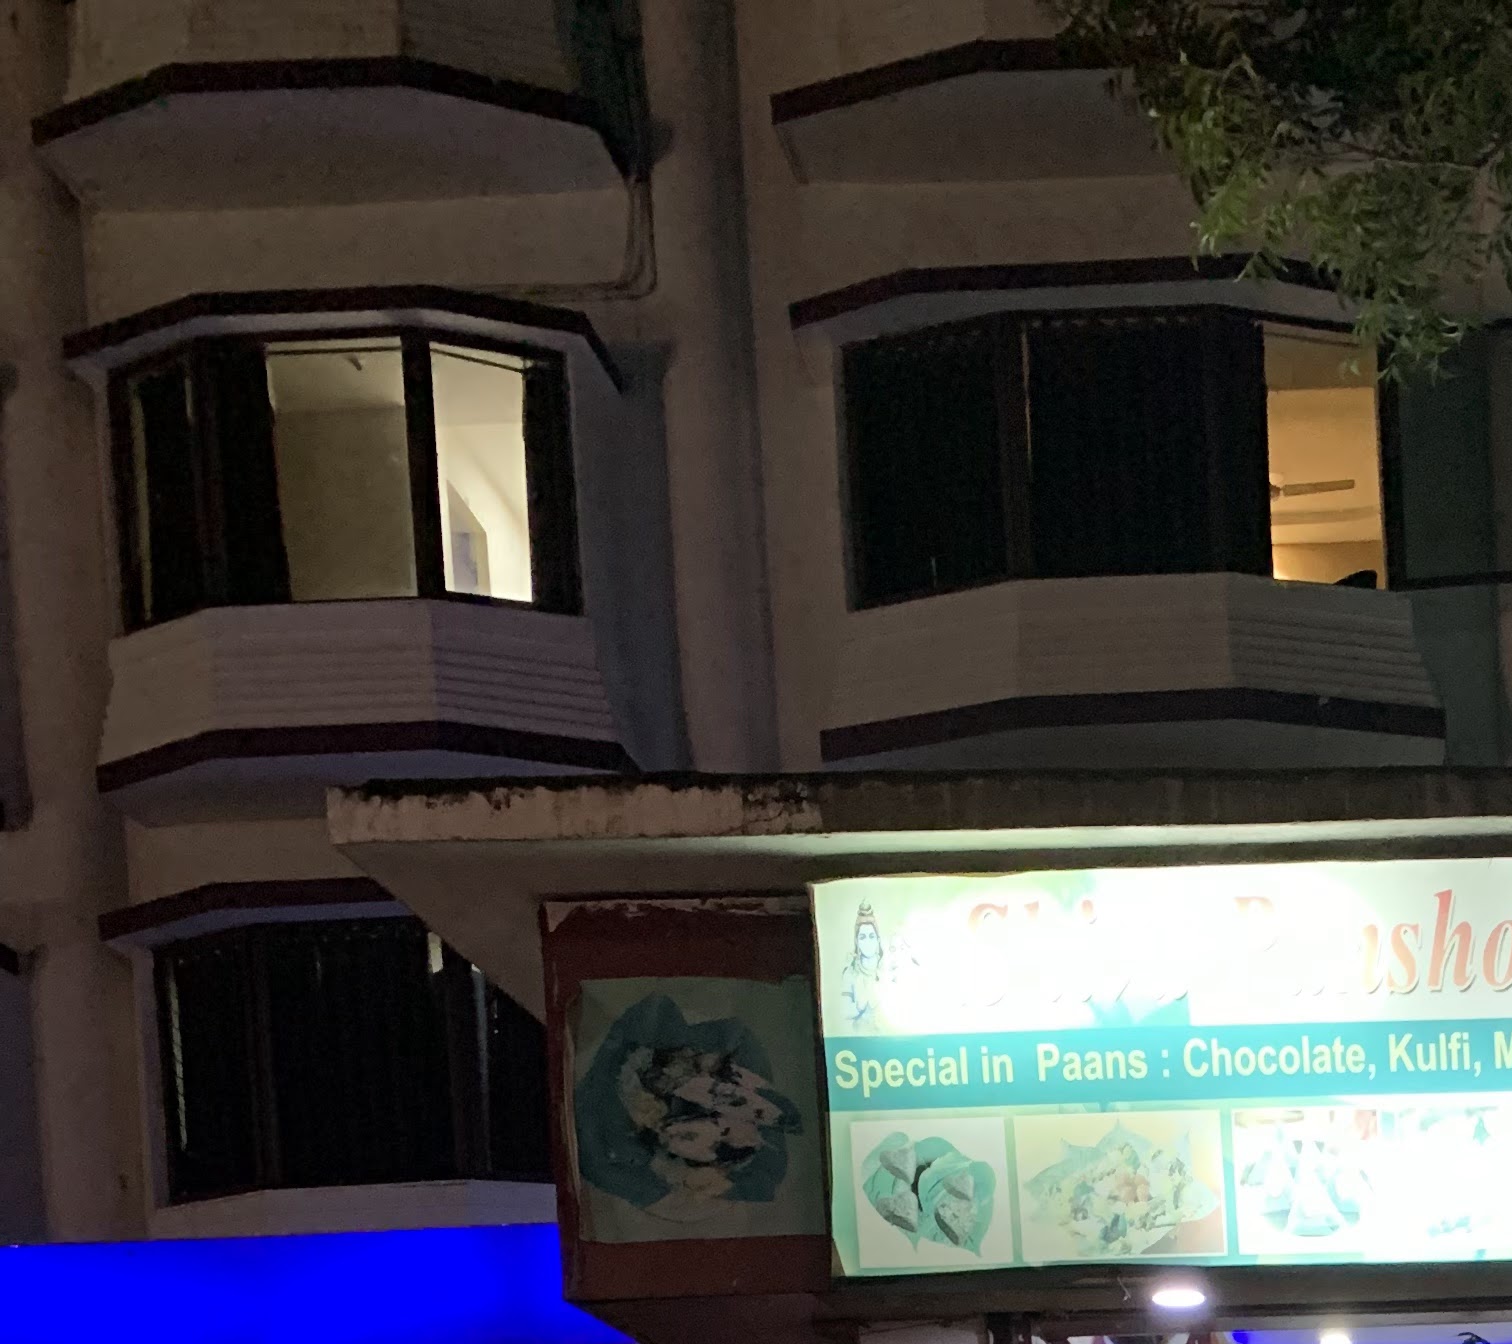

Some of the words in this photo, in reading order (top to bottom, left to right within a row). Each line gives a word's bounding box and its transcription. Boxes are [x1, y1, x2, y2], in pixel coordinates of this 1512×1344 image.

[834, 1046, 969, 1097] Special
[981, 1045, 1015, 1083] in
[1037, 1040, 1148, 1082] Paans
[1182, 1035, 1377, 1081] Chocolate,
[1388, 1031, 1482, 1078] Kulfi,
